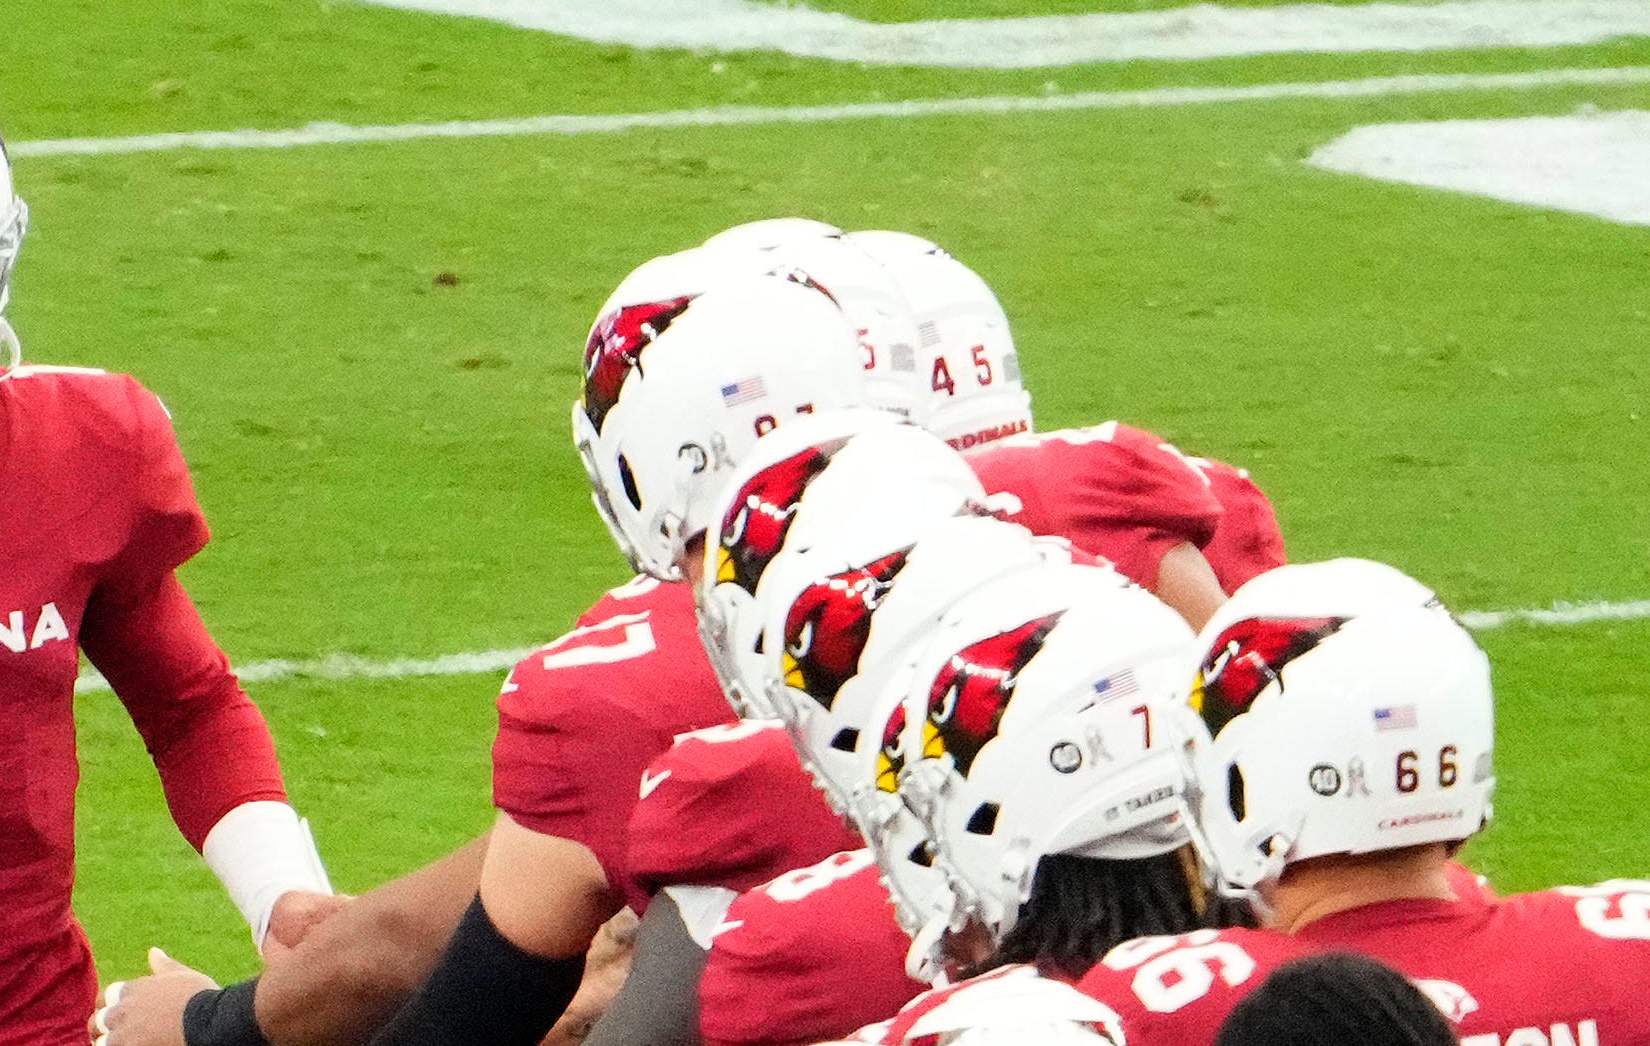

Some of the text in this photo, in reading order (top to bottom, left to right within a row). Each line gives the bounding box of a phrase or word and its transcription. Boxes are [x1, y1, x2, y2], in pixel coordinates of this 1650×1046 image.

[931, 344, 993, 397] 45
[1131, 704, 1151, 749] 7
[1395, 744, 1458, 794] 66
